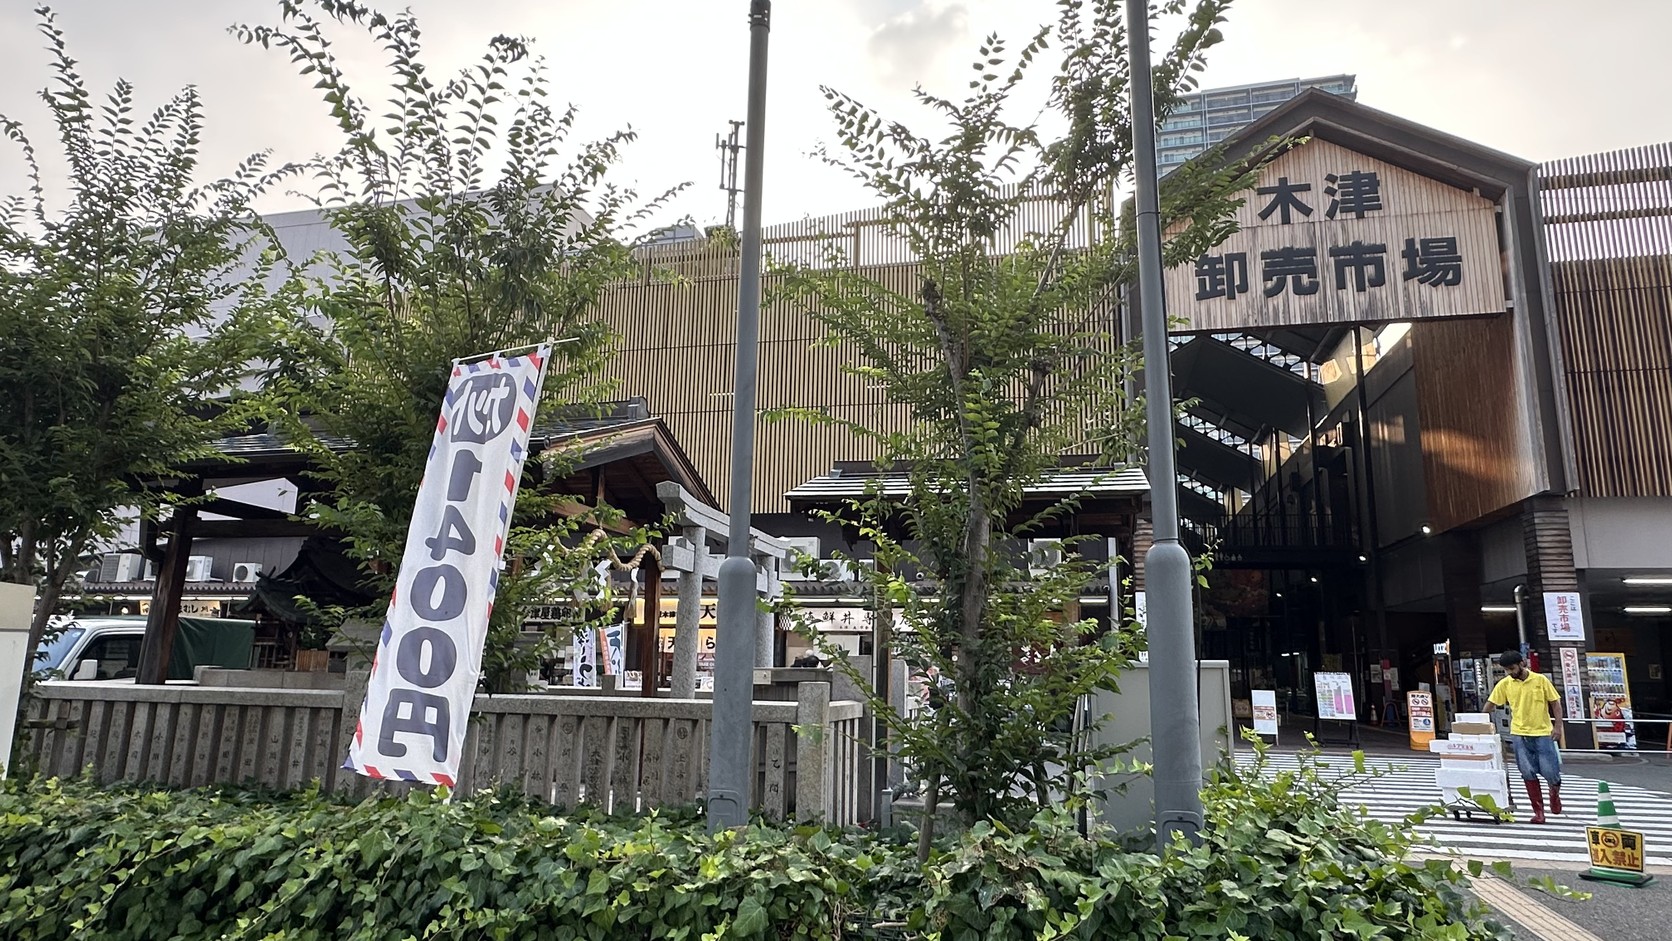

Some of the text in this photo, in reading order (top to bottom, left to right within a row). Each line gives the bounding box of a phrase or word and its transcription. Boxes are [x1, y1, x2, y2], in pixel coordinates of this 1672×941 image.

[1256, 170, 1382, 224] 木津
[1194, 236, 1462, 301] 卸売市場
[700, 603, 717, 619] 天
[1556, 595, 1571, 633] 卸売市場
[1569, 595, 1577, 612] ここは
[1591, 848, 1640, 868] 進入禁止
